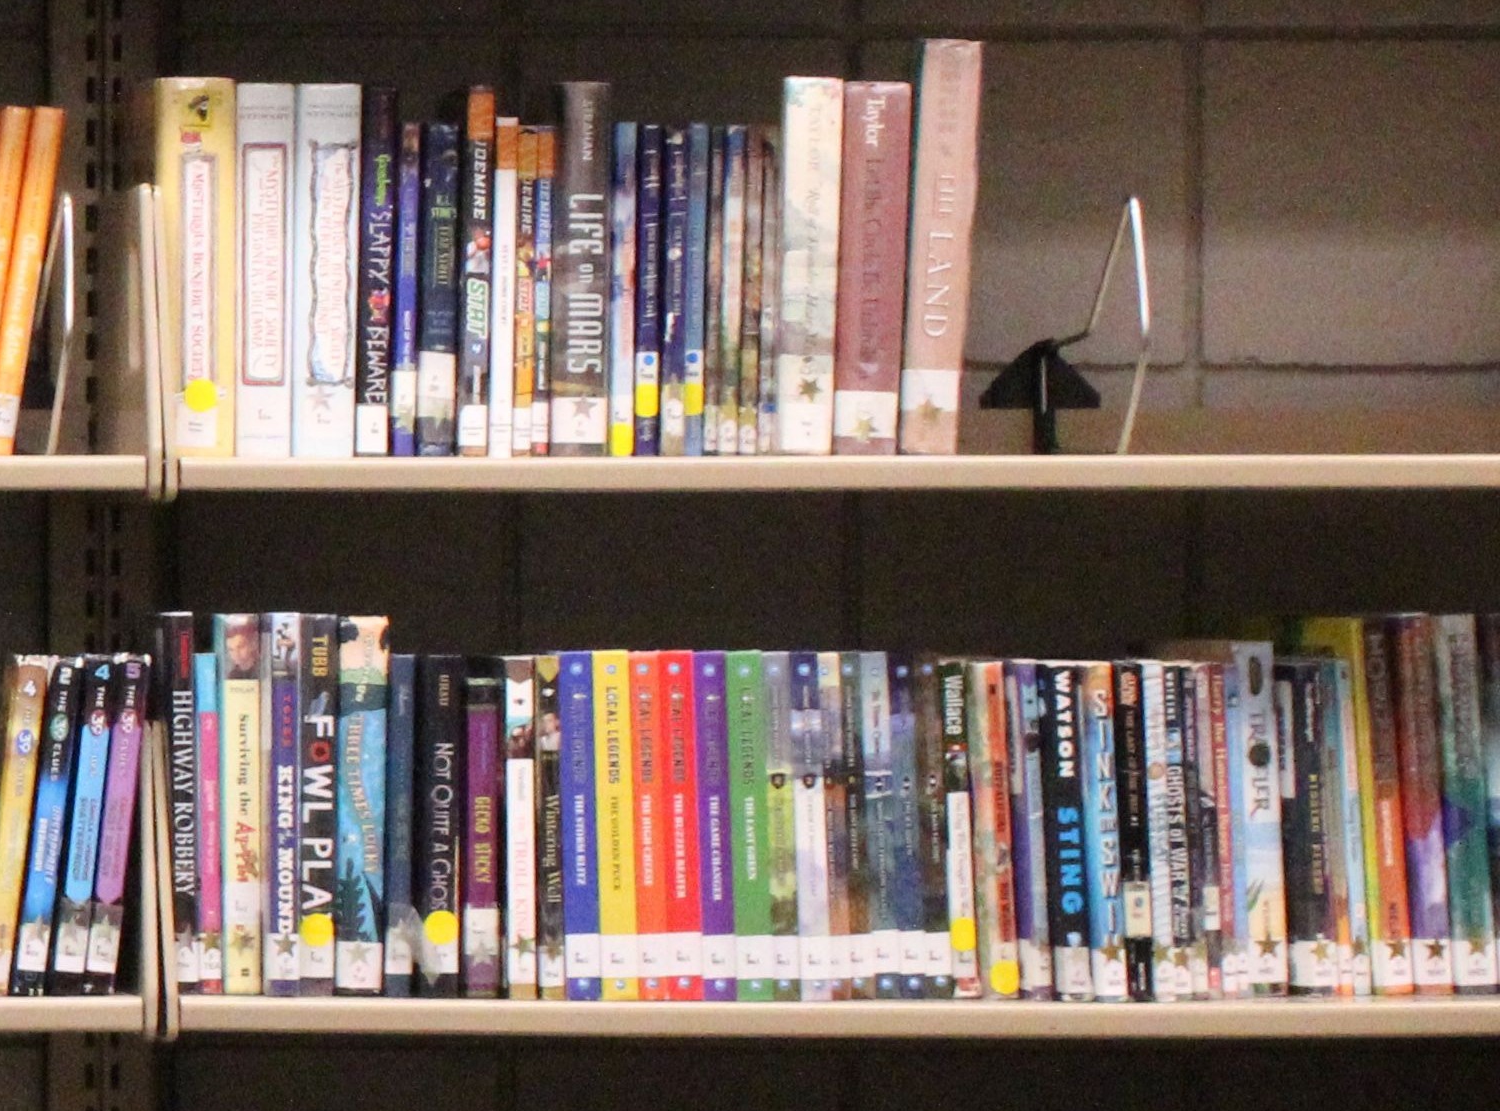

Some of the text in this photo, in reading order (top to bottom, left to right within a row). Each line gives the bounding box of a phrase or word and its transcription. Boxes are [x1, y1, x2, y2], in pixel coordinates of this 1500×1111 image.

[864, 96, 886, 147] Taylor
[368, 212, 391, 404] SLAPPY BEWARE
[568, 195, 605, 372] LIFE on MARS
[924, 231, 955, 337] LAND
[171, 690, 195, 895] HIGHWAY ROBBERY
[303, 635, 335, 822] TUBB FOWL
[1055, 671, 1085, 914] WATSON STING
[543, 794, 562, 902] Wintering Well
